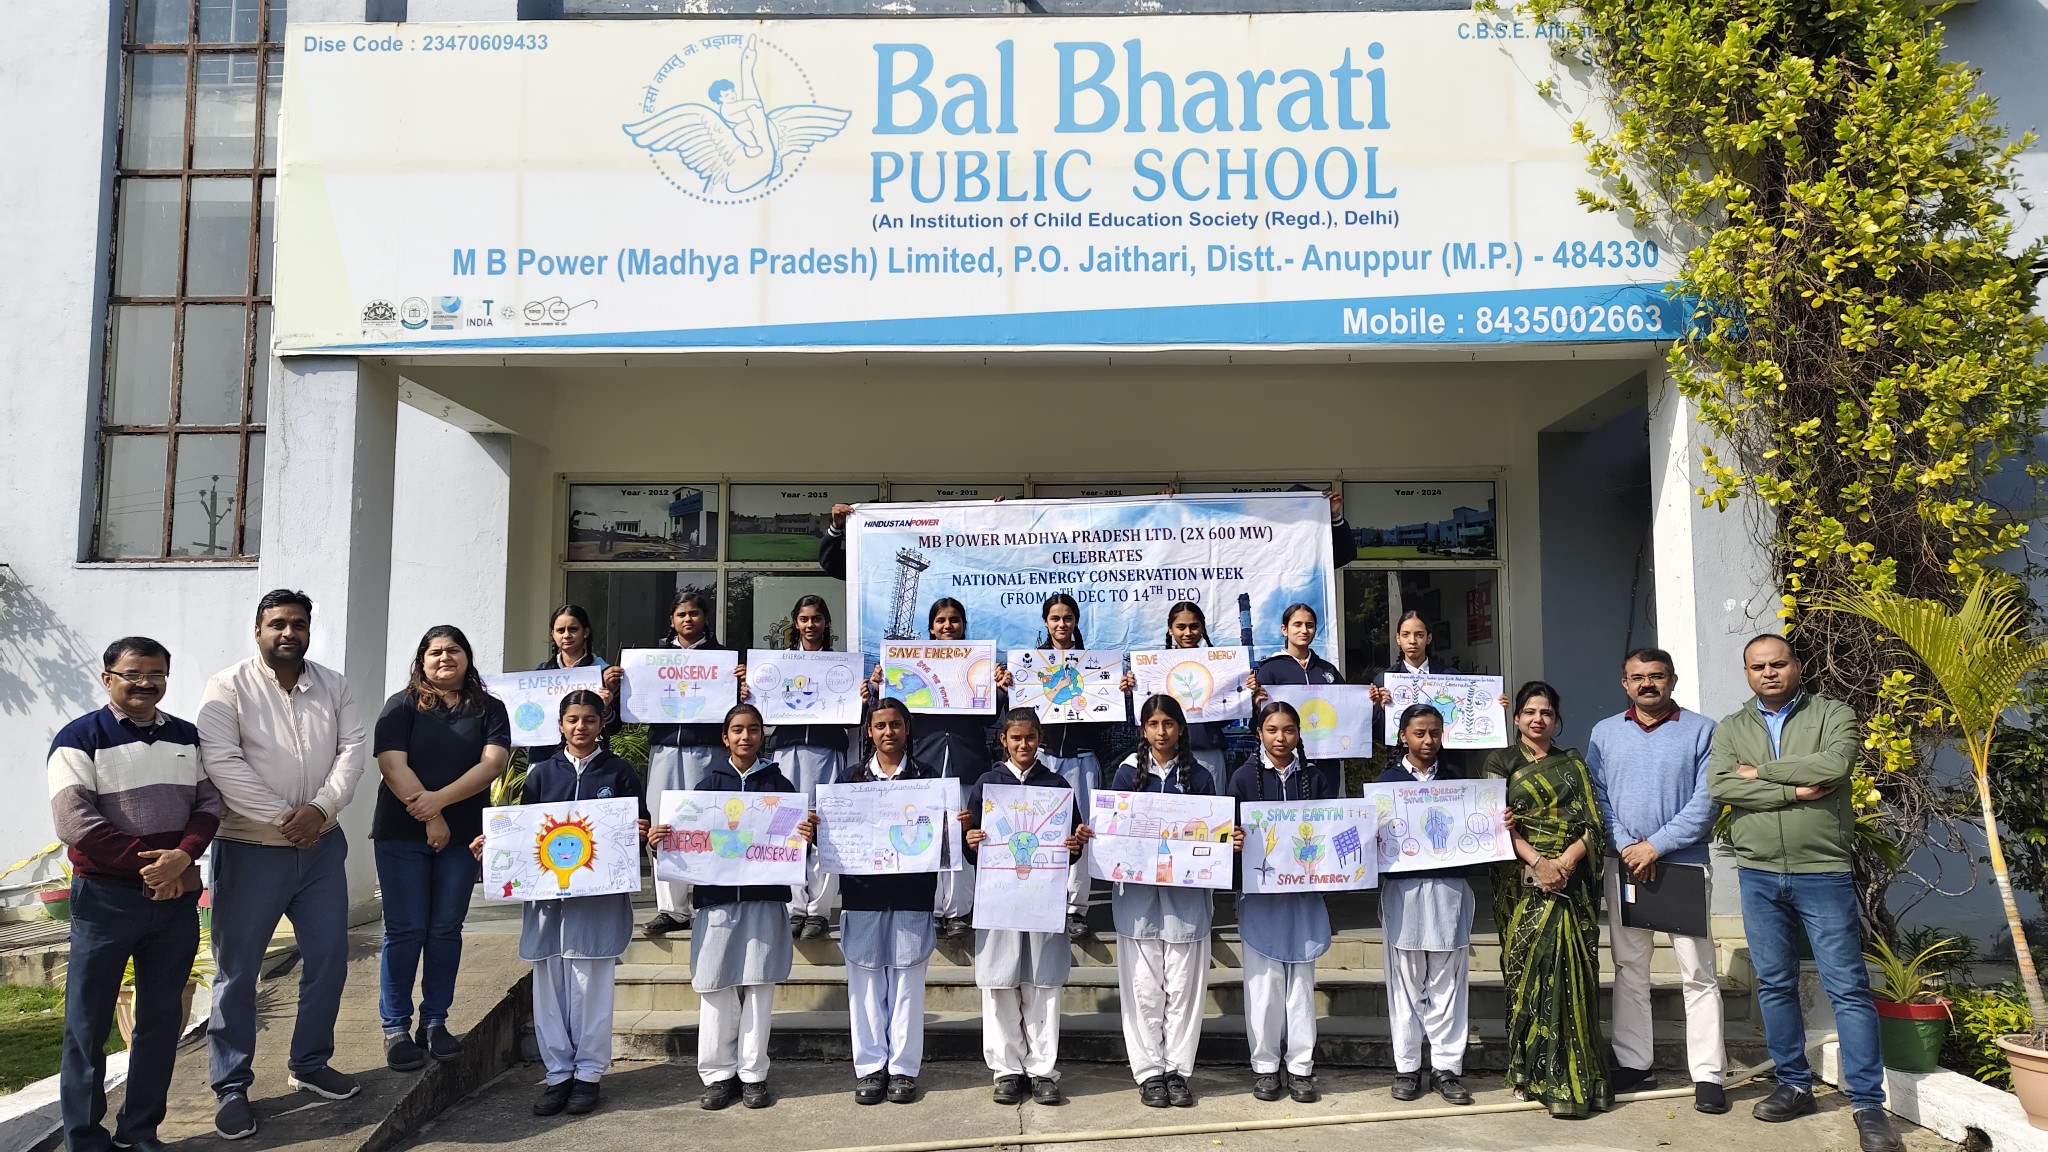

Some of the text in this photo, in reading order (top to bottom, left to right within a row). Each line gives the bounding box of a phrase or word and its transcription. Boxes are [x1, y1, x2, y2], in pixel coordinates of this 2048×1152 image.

[1457, 22, 1530, 40] C.B.S.E.
[304, 36, 346, 52] Dise
[353, 35, 404, 52] Code
[422, 34, 548, 51] 23470609433
[653, 53, 686, 84] नयतु
[871, 37, 1391, 136] Bal Bharati
[869, 145, 1398, 203] PUBLIC SCHOOL
[871, 209, 1400, 231] (An Institution of Child Education Society (Regd.), Delhi)
[453, 249, 477, 276] M
[487, 248, 506, 276] B
[517, 248, 608, 276] Power
[616, 246, 740, 283] (Madhya
[749, 246, 879, 281] Pradesh)
[888, 245, 1004, 278] Limited,
[1014, 246, 1069, 273] P.O.
[1079, 244, 1197, 277] Jaithari,
[1207, 244, 1294, 272] Distt.-
[1301, 244, 1432, 278] Anuppur
[1441, 241, 1524, 278] (M.P.)
[1552, 241, 1660, 269] 484330
[466, 318, 494, 327] INDIA
[1342, 307, 1446, 335] Mobile
[1476, 304, 1663, 334] 8435002663
[781, 491, 801, 499] Year
[807, 491, 829, 499] 2015
[918, 526, 1273, 549] MB POWER MADHYA PRADESH LTD. (2X 600 MW)
[1052, 549, 1143, 565] CELEBRATES
[952, 567, 1244, 587] NATIONAL ENERGY CONSERVATION WEEK
[1000, 591, 1047, 608] (FROM
[1078, 590, 1106, 603] DEC
[1109, 589, 1129, 602] TO
[1167, 586, 1201, 604] DEC)
[645, 653, 691, 667] ENERGY
[782, 653, 806, 661] ENERGY
[888, 646, 973, 659] SAVE ENERGY
[1135, 650, 1237, 666] SAVE ENERGY
[658, 665, 719, 680] CONSERVE
[518, 675, 571, 691] ENERGY
[1398, 788, 1418, 798] SAVE
[1266, 807, 1344, 822] SAVE EARTH
[663, 831, 711, 851] ENERGY
[745, 845, 800, 861] CONSERVE
[1277, 873, 1351, 886] SAVE ENERGY
